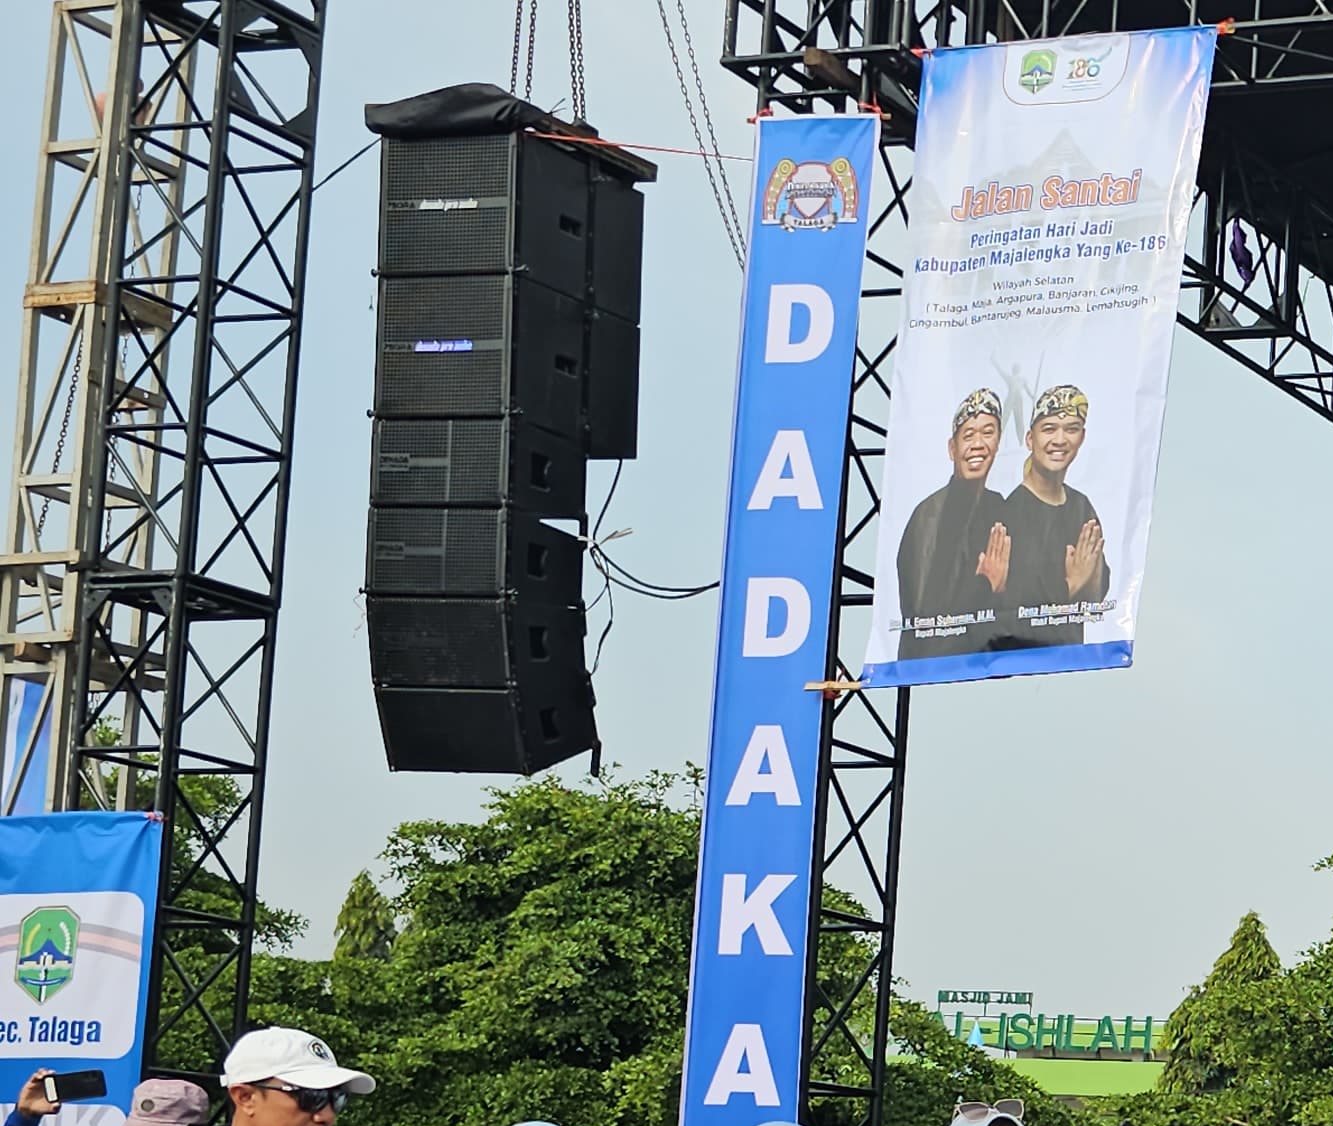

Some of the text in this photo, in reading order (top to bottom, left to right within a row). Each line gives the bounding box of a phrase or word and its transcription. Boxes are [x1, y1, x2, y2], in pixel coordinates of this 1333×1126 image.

[951, 168, 1142, 221] Jalan Santai
[971, 220, 1113, 248] Peringatan Hari Jadi
[915, 235, 1167, 275] Kabupaten Majalengka Yang Ke-186
[993, 276, 1074, 291] Wilayah Selatan
[29, 1016, 101, 1045] Talaga
